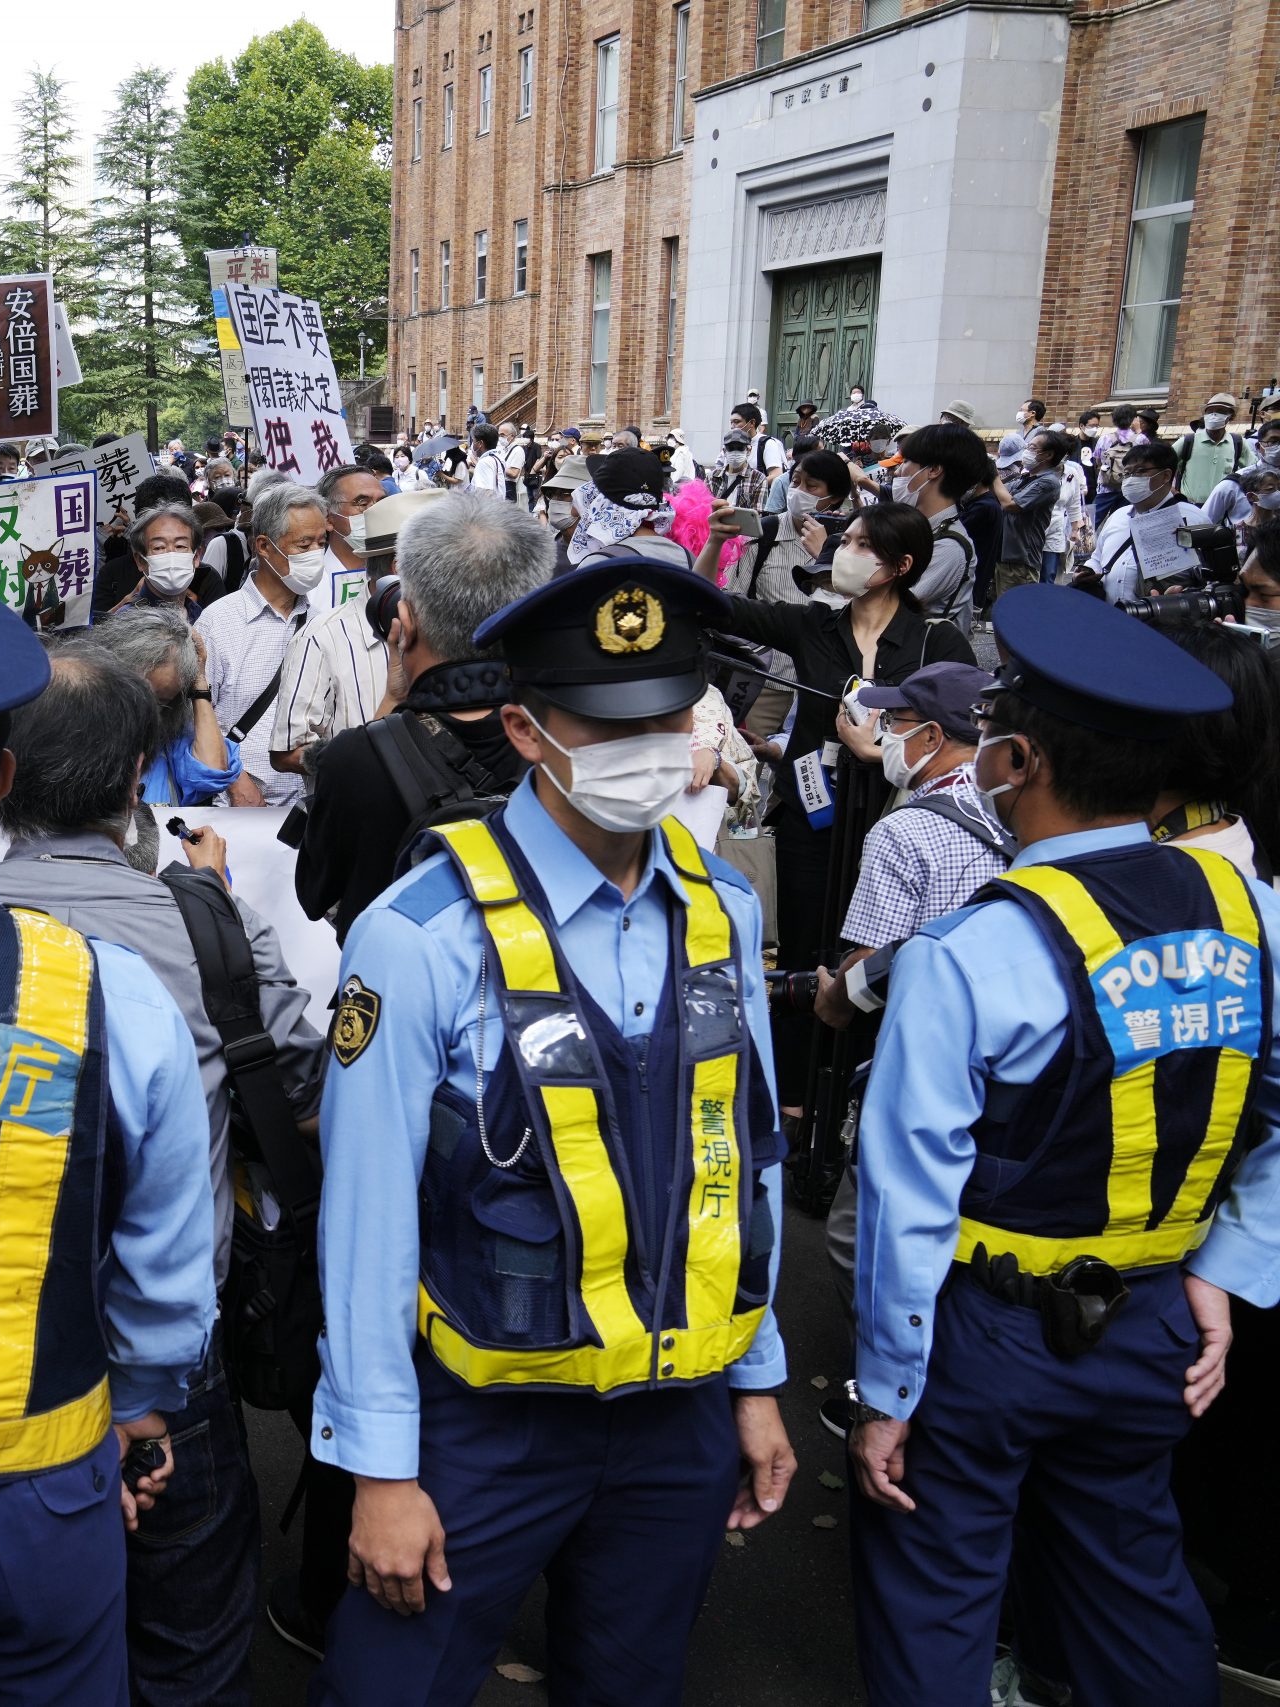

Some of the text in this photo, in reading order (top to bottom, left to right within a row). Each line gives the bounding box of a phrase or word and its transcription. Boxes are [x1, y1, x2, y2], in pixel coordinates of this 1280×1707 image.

[226, 257, 270, 284] 平和
[233, 249, 269, 260] PEACE
[5, 287, 40, 417] 安倍国葬
[234, 290, 329, 358] 国会不要
[250, 366, 340, 415] 閣議決定
[264, 416, 347, 475] 独裁
[54, 481, 91, 599] 国葬
[1099, 939, 1252, 1009] POLICE
[1122, 995, 1245, 1051] 警視庁
[699, 1098, 731, 1219] 警視庁
